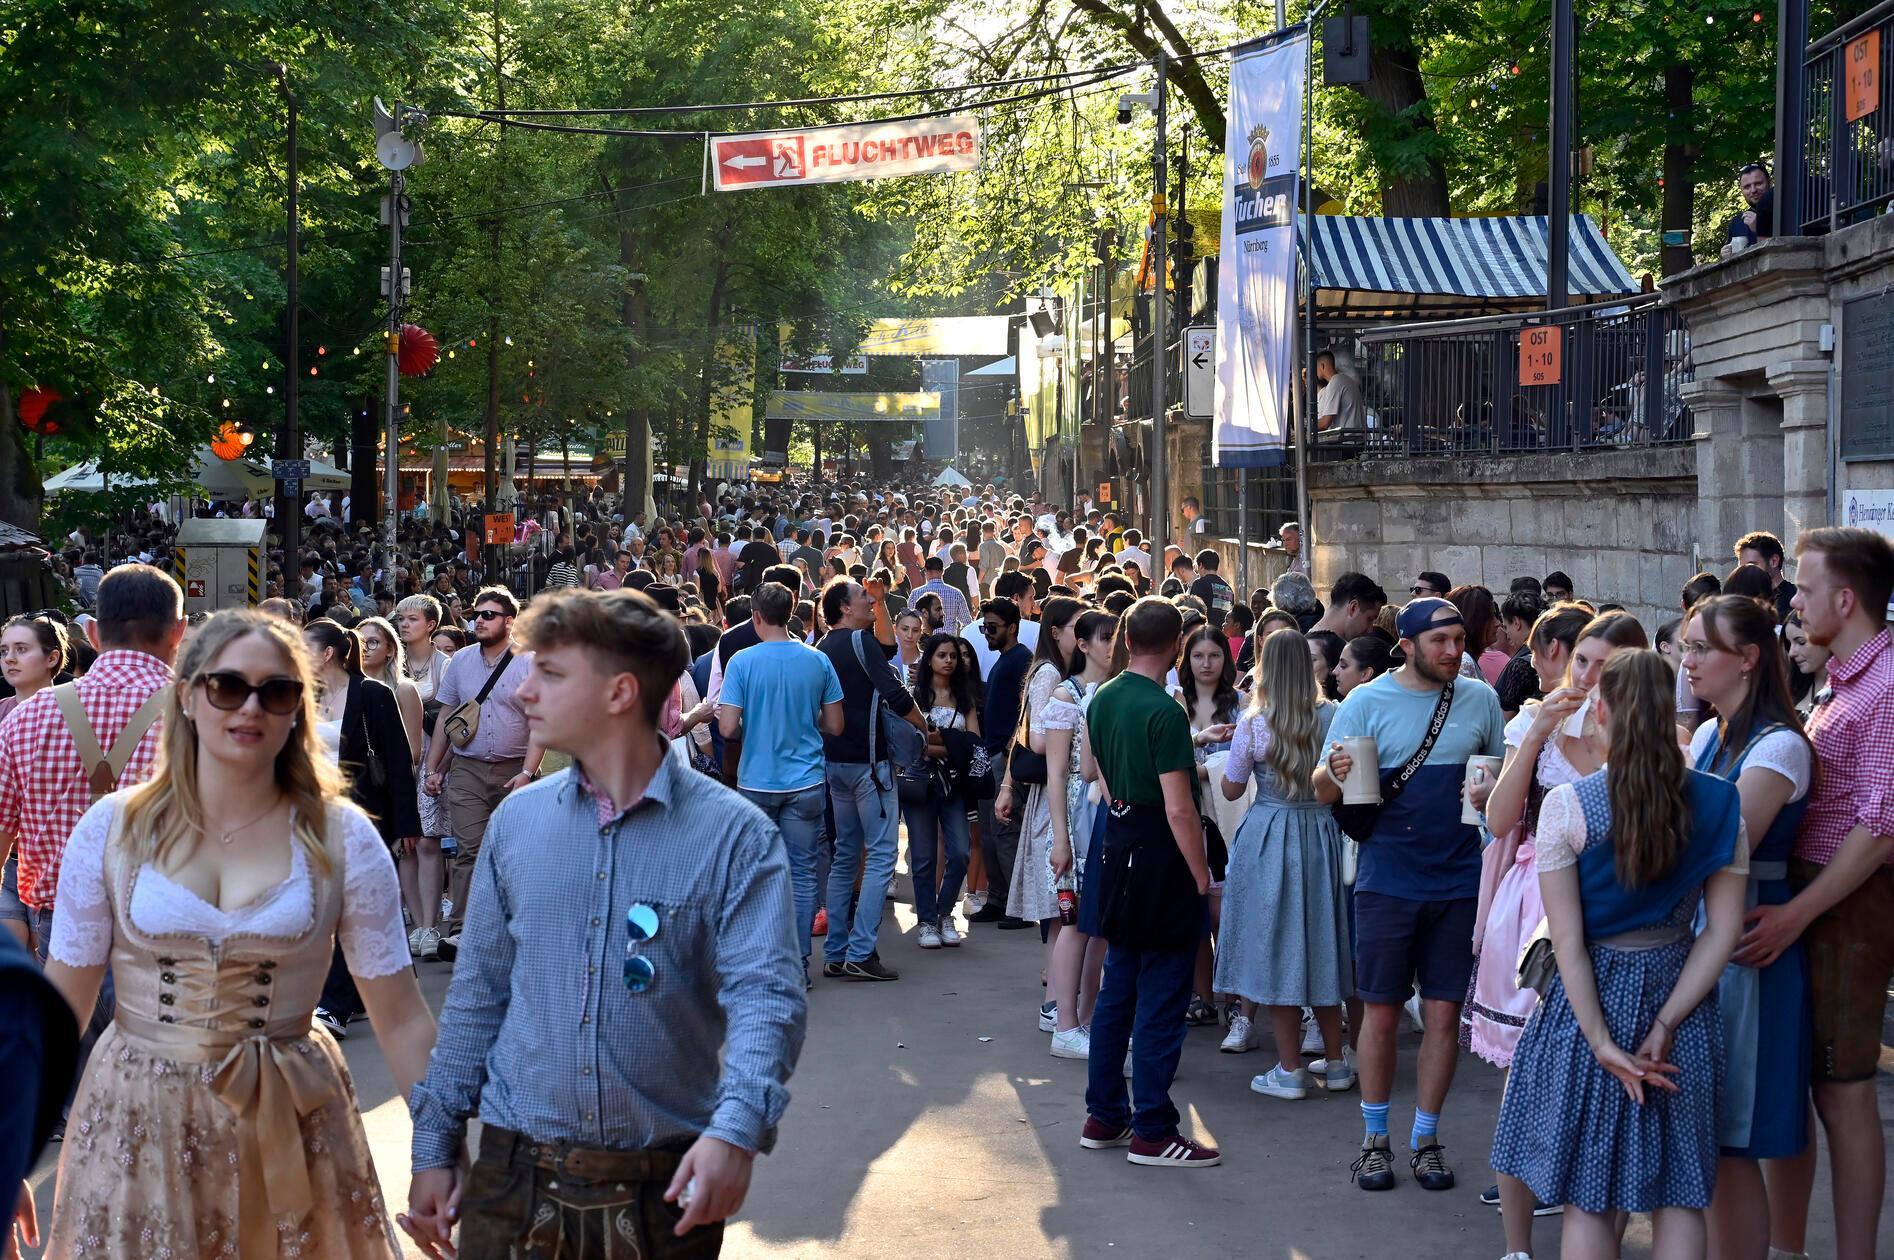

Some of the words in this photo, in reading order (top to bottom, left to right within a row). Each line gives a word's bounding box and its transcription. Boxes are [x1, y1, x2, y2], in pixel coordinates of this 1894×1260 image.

[1853, 40, 1869, 63] OST
[1863, 68, 1873, 88] 10
[812, 131, 974, 168] FLUCHTWEG
[1530, 331, 1549, 346] OST
[1528, 354, 1532, 367] 1
[1541, 352, 1553, 366] 10
[1533, 372, 1545, 381] SOS
[1431, 701, 1449, 735] adidas
[1401, 748, 1428, 781] adidas
